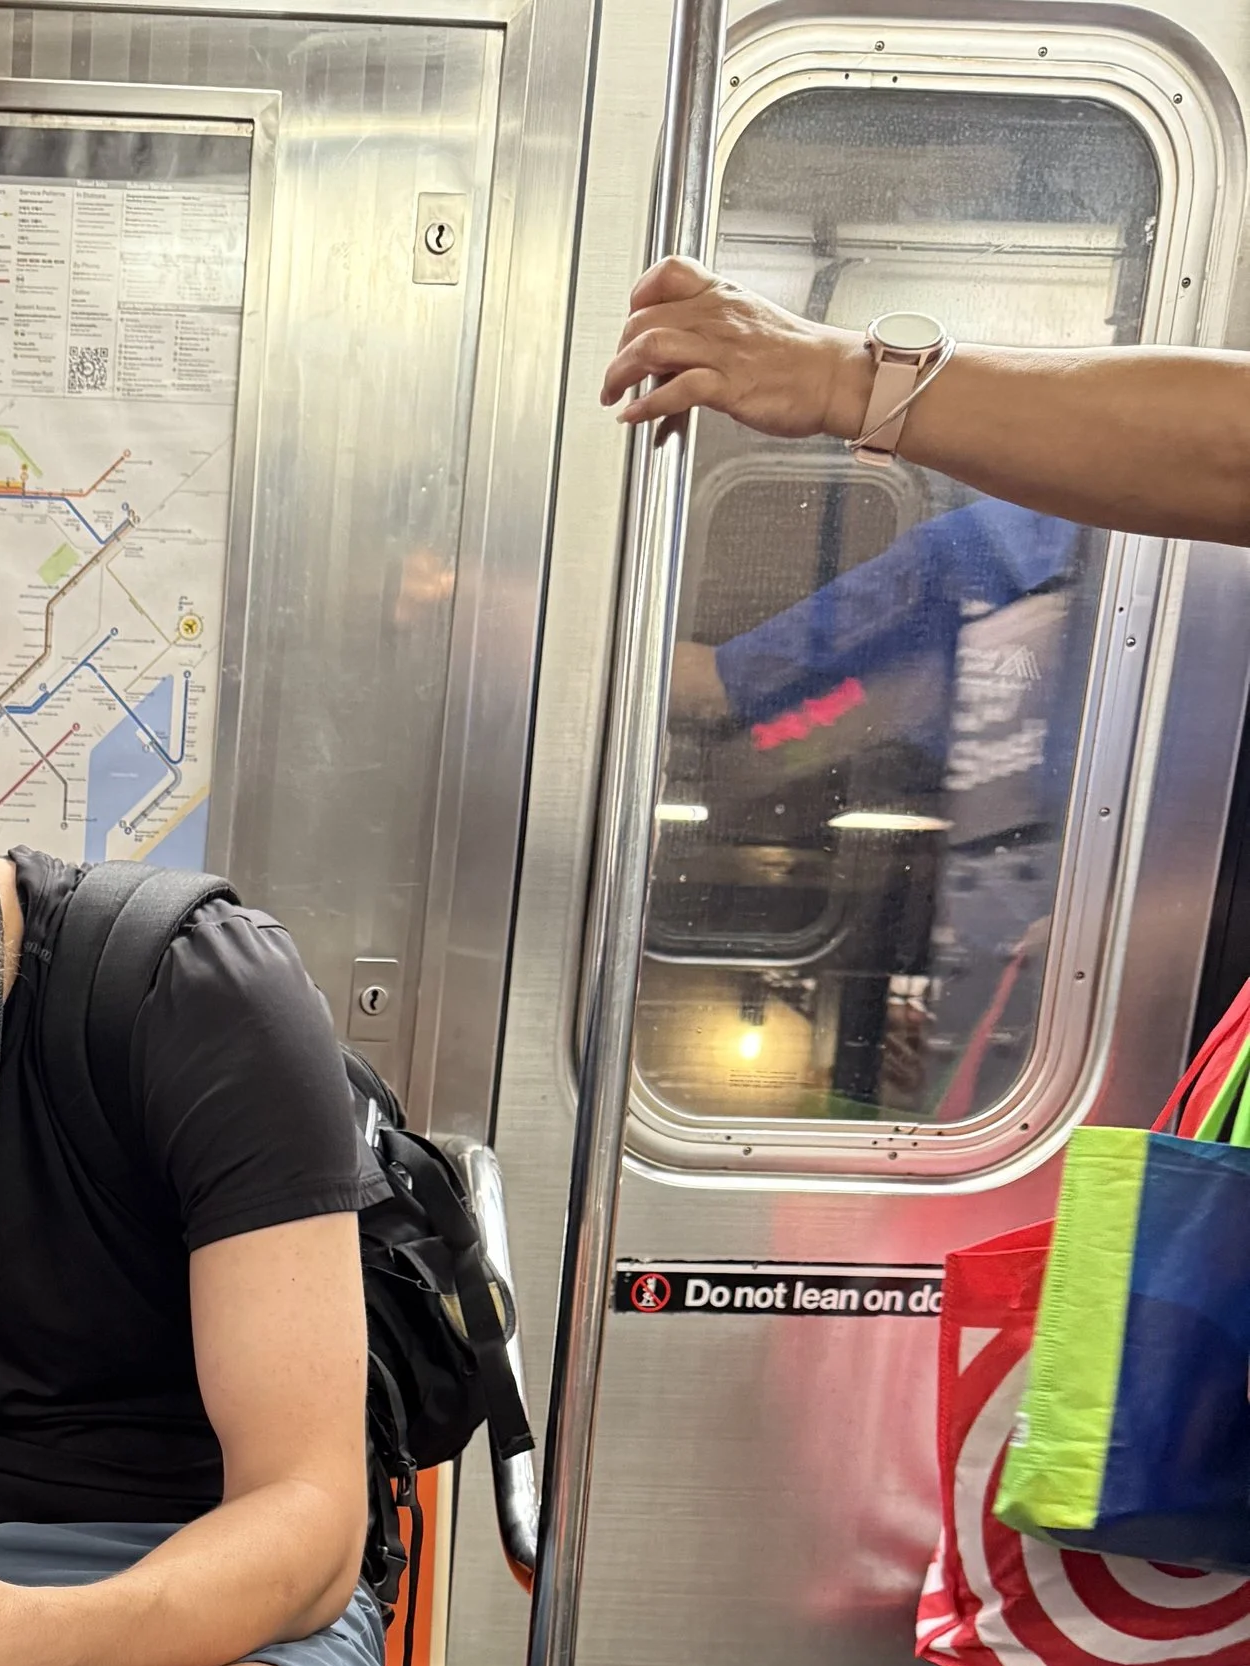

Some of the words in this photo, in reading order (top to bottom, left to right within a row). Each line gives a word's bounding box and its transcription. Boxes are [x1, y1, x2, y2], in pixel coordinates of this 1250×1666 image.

[684, 1278, 731, 1308] Do
[734, 1281, 788, 1310] not
[793, 1281, 860, 1311] lean
[863, 1289, 903, 1312] on
[909, 1284, 943, 1313] do
